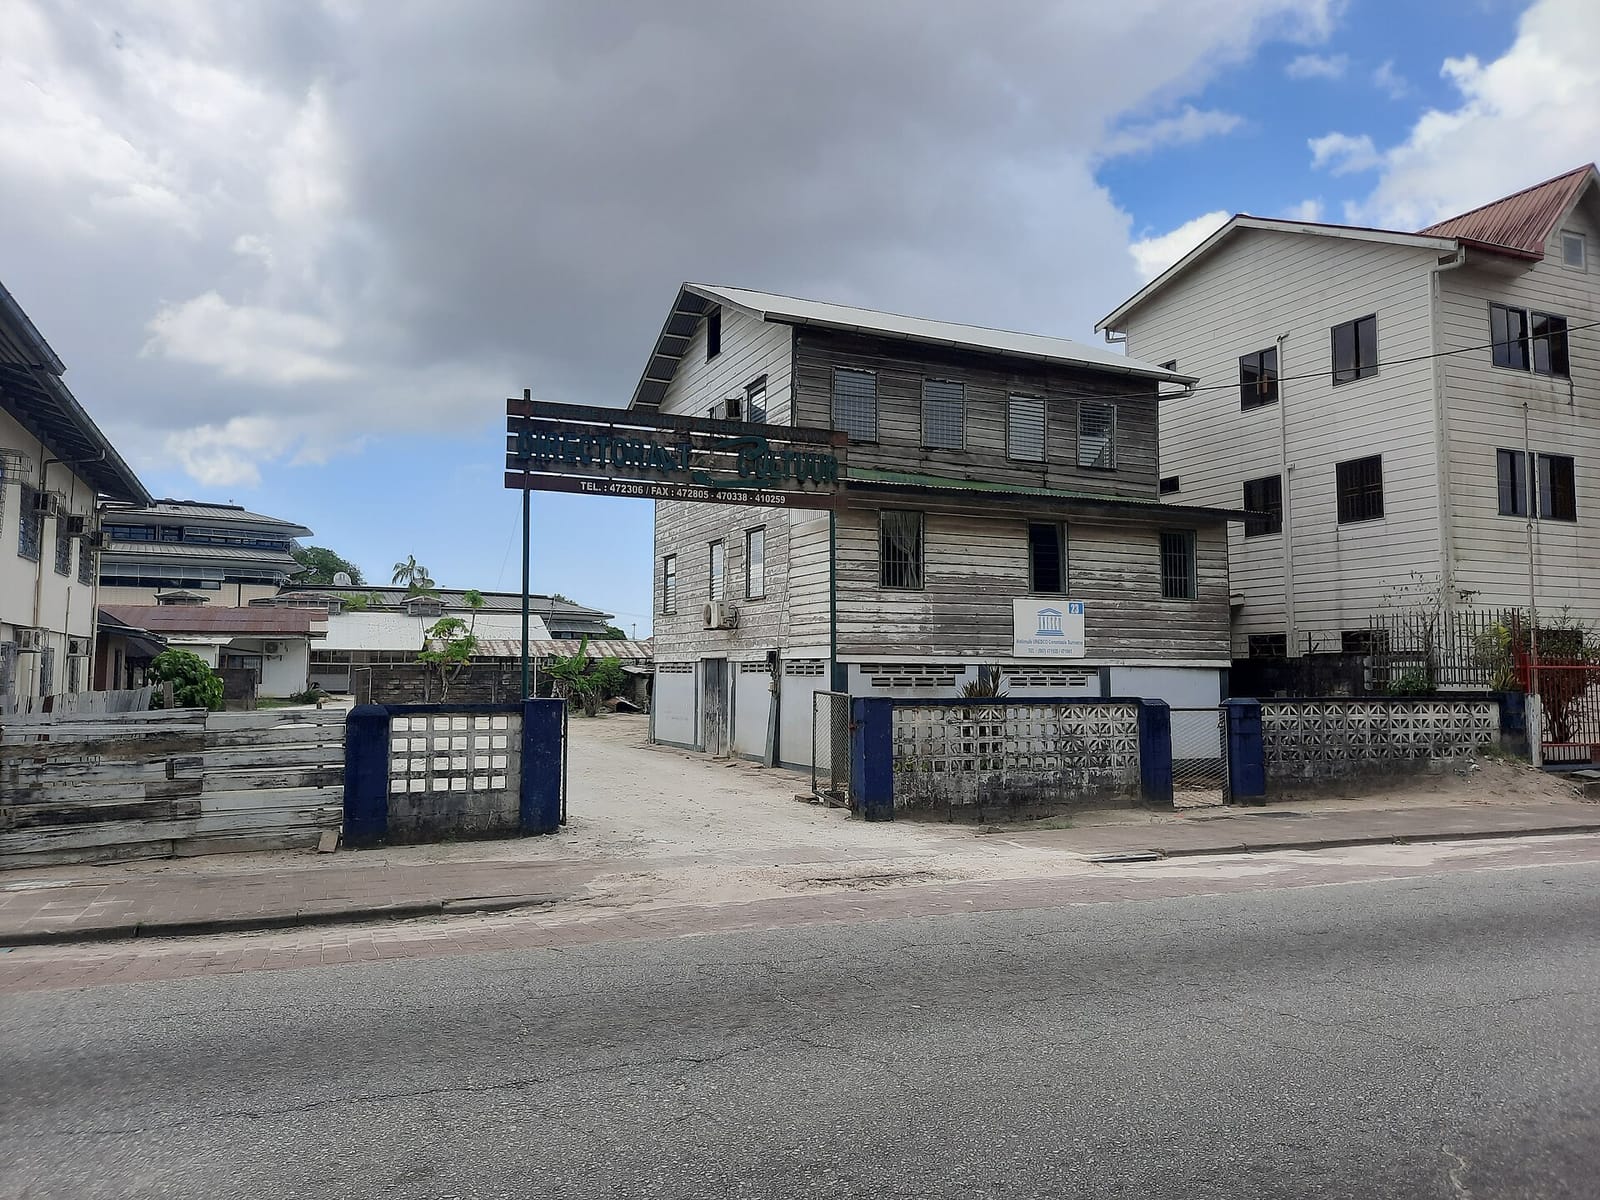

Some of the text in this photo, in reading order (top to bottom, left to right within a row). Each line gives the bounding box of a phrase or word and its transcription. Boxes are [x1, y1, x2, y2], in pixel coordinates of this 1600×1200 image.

[580, 481, 601, 492] TEL.
[609, 483, 643, 495] 472306
[651, 486, 669, 496] FAX
[676, 488, 709, 499] 472805
[716, 491, 748, 502] 470338
[754, 493, 786, 504] 410259
[1070, 604, 1079, 613] 23
